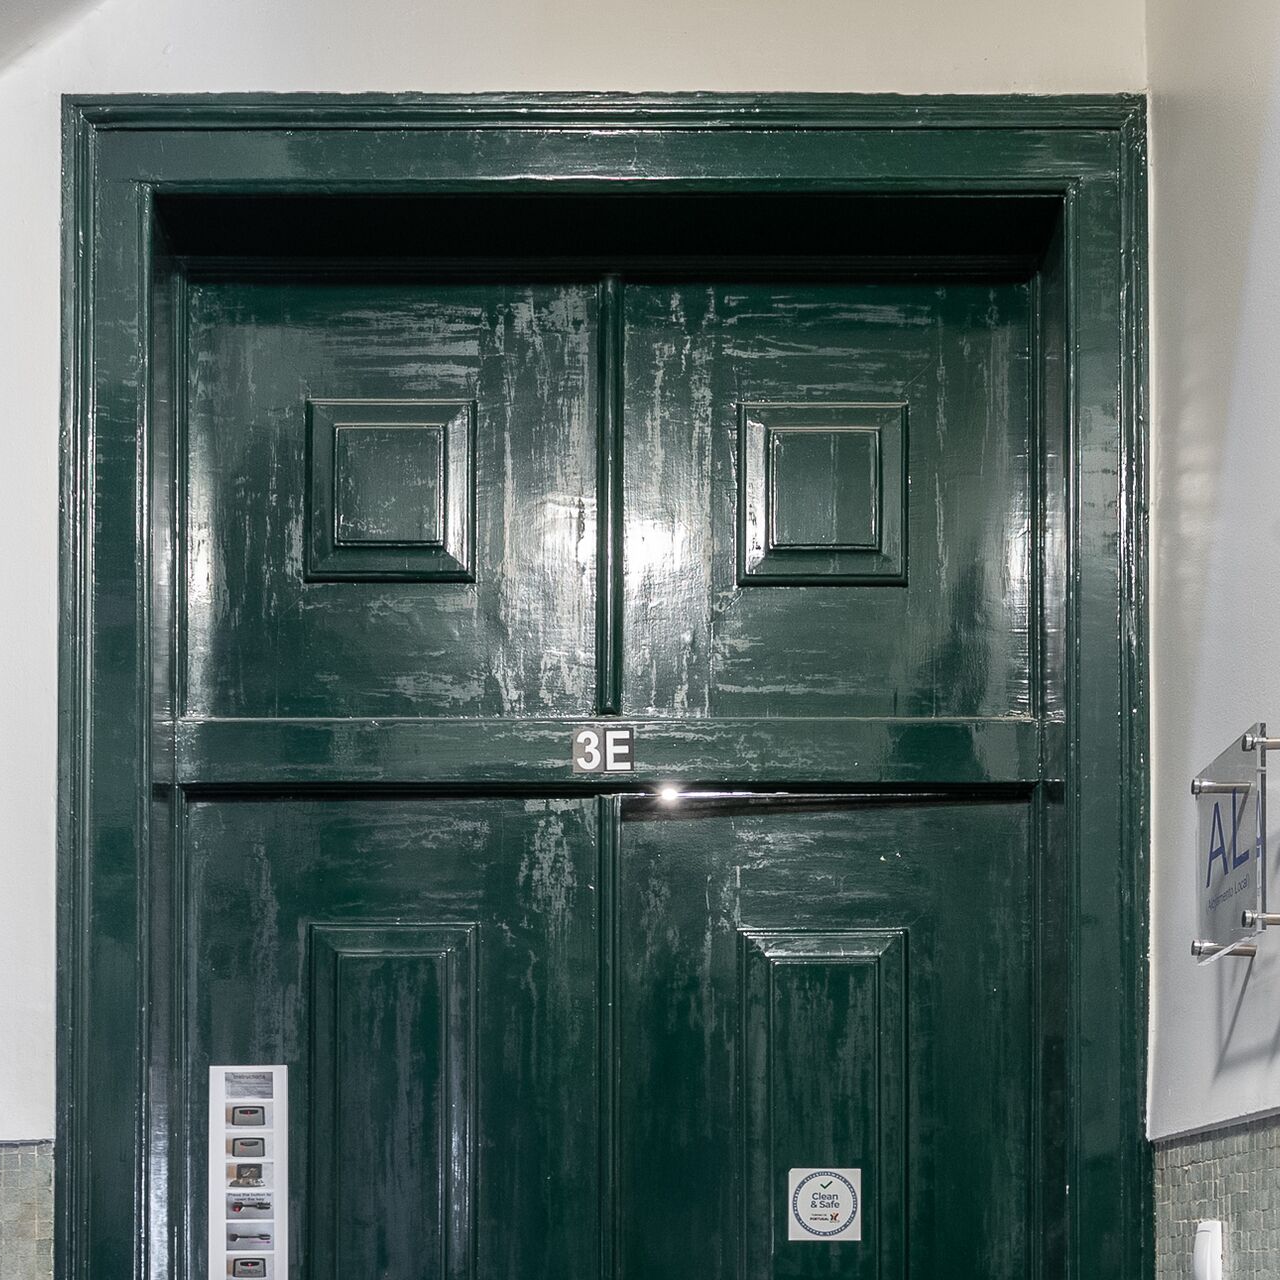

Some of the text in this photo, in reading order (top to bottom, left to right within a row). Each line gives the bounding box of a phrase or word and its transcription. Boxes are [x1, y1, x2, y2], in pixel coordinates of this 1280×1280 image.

[576, 730, 632, 770] 3E
[1205, 787, 1250, 888] AL
[811, 1200, 840, 1208] & Safe
[812, 1192, 838, 1200] Clean
